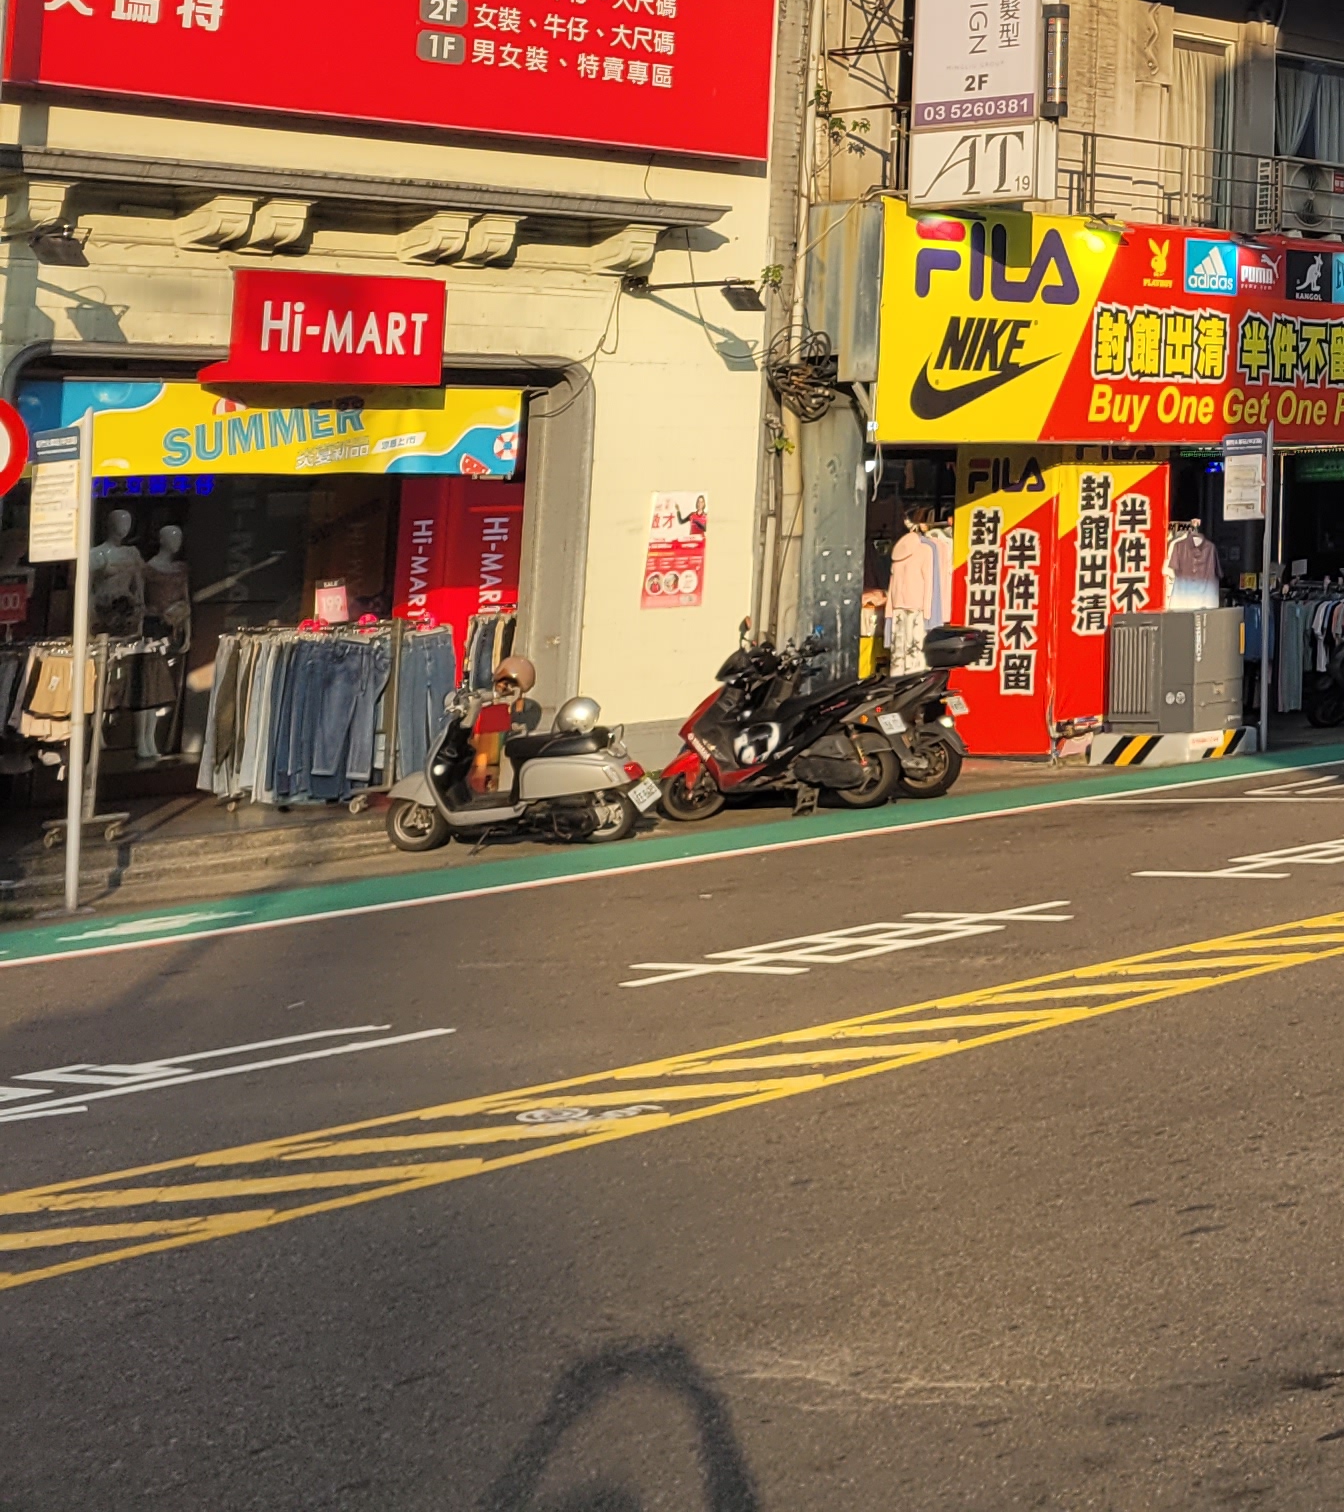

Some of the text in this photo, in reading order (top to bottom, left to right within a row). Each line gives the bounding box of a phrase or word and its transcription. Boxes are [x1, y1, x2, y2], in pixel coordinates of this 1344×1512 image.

[427, 34, 457, 59] 1F
[472, 1, 676, 58] 女裝、牛仔、大尺碼
[470, 37, 673, 89] 男女裝、特賣專區
[964, 73, 989, 92] 2F
[924, 101, 1030, 121] 03 5260381
[915, 131, 1031, 199] AT 19
[914, 219, 1081, 306] FILA
[1187, 272, 1234, 291] adidas
[1240, 265, 1275, 284] PUMA
[1295, 292, 1323, 302] KANGOL
[260, 299, 429, 357] Hi-MART
[932, 317, 1033, 372] NIKE
[1093, 303, 1229, 383] 封館出清
[161, 395, 366, 468] SUMMER
[1088, 384, 1149, 433] Buy
[1157, 388, 1215, 426] One
[1222, 388, 1269, 426] Get
[1276, 389, 1327, 426] One
[967, 455, 1046, 494] FILA
[1075, 473, 1112, 634] 封館出清
[1002, 531, 1039, 692] 半件不留
